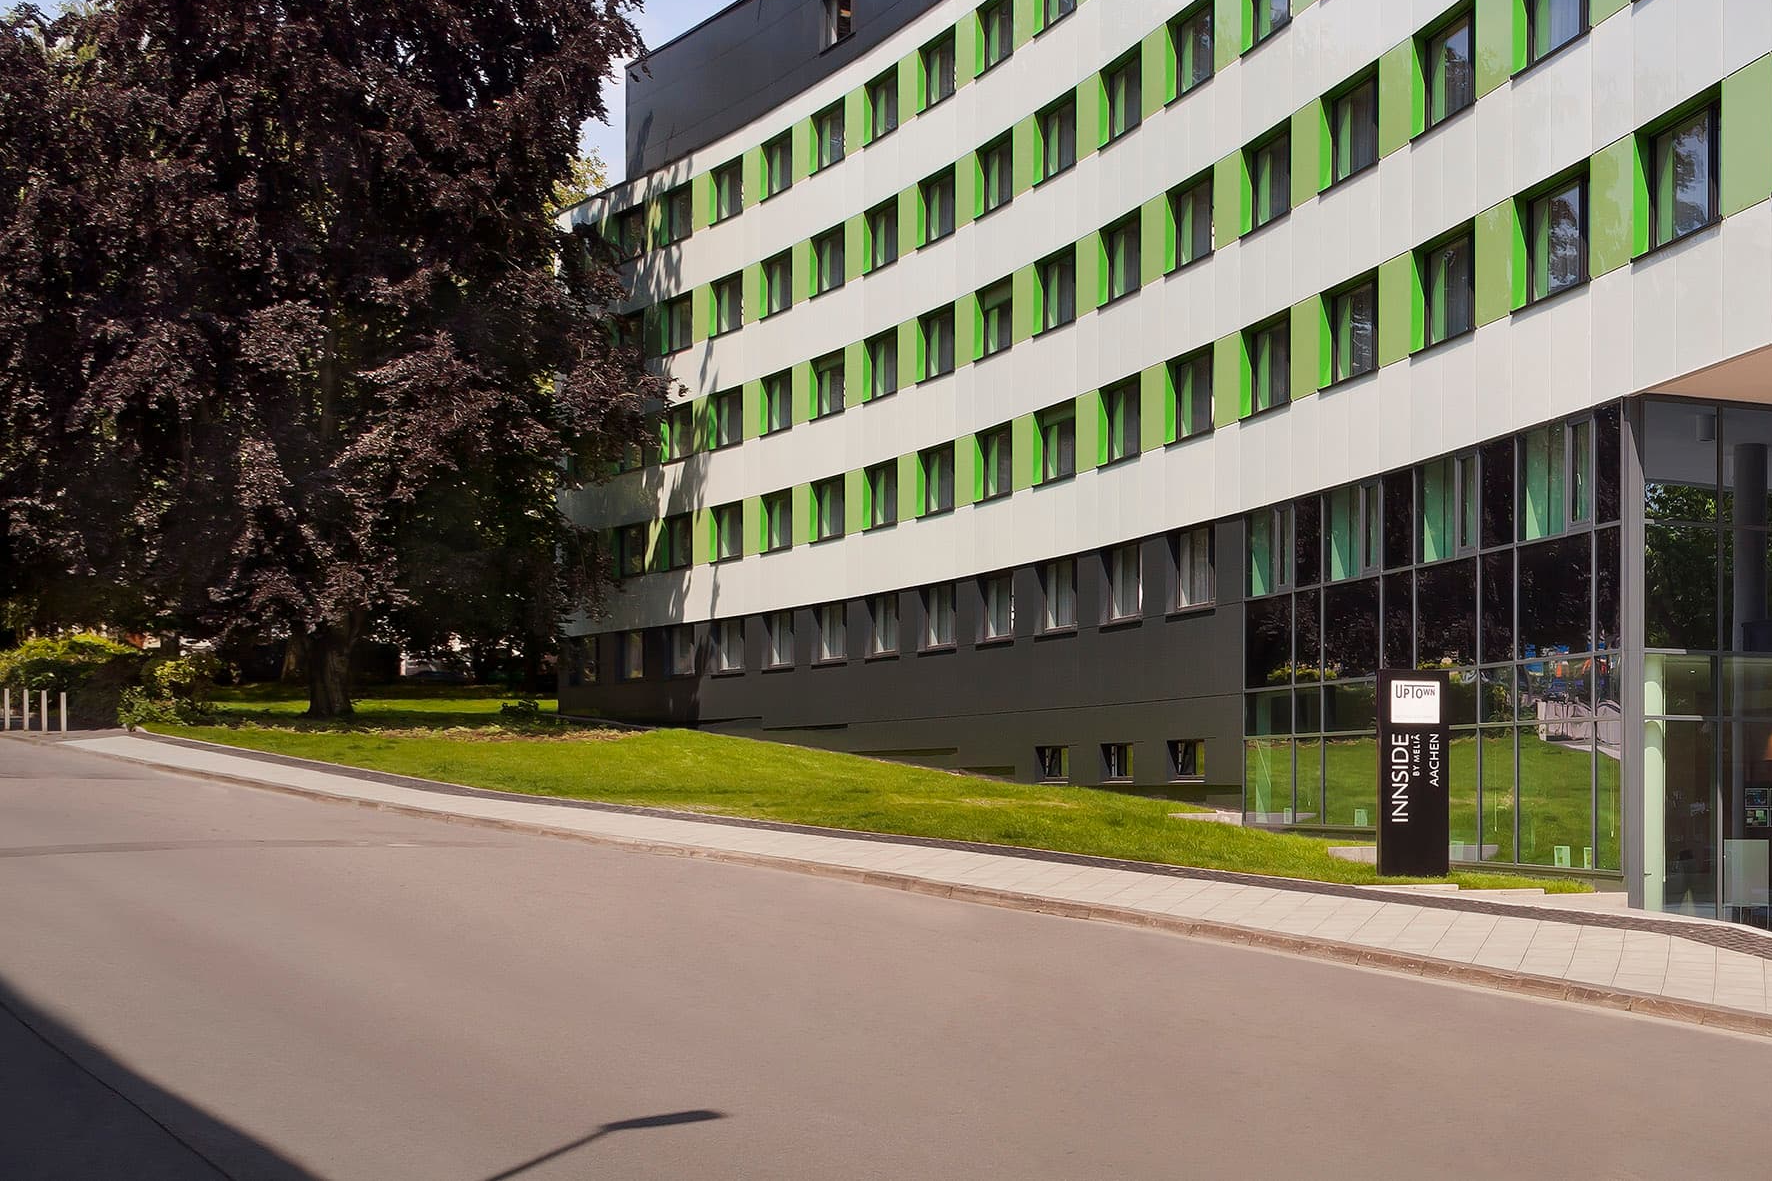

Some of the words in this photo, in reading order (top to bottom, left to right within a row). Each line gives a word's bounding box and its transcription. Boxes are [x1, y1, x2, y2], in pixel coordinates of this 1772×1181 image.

[1391, 733, 1409, 823] INNSIDE
[1412, 765, 1420, 776] BY
[1428, 733, 1440, 787] AACHEN
